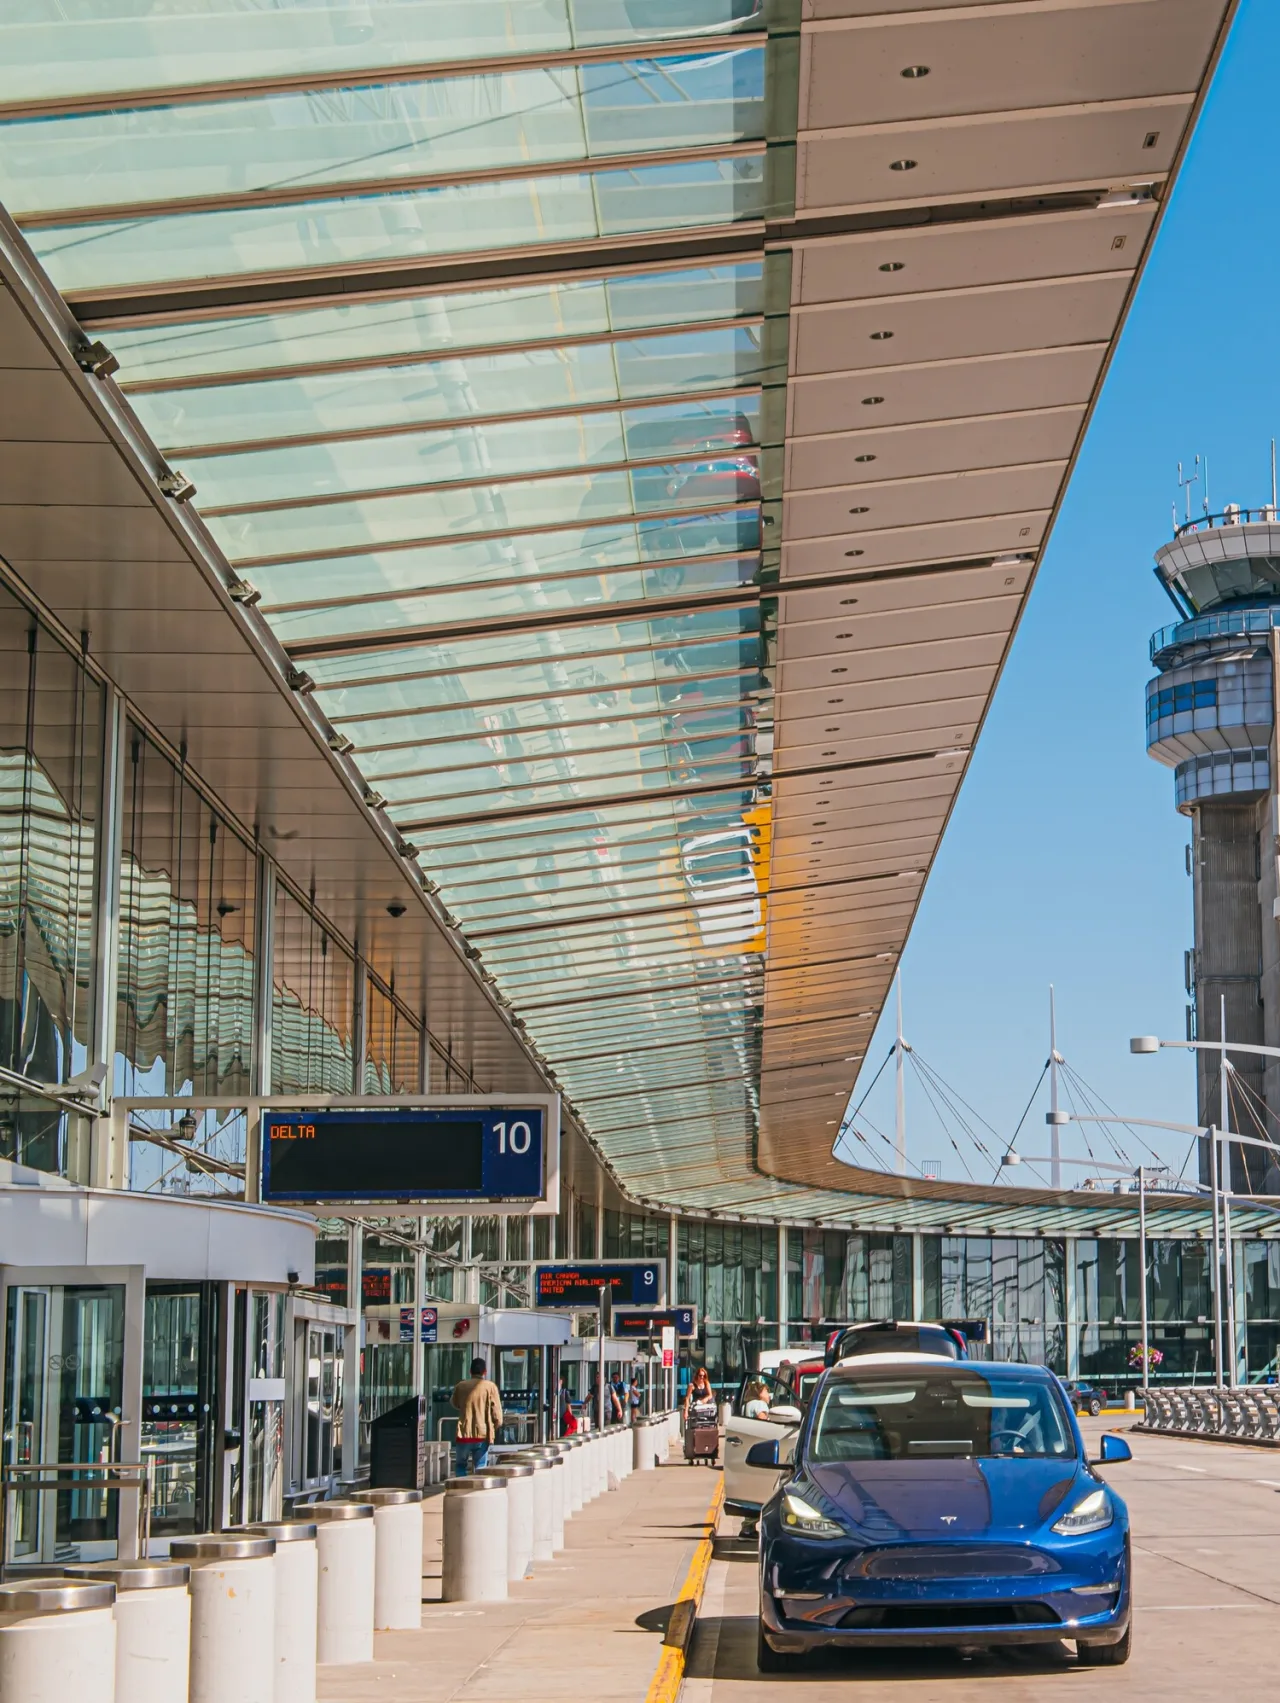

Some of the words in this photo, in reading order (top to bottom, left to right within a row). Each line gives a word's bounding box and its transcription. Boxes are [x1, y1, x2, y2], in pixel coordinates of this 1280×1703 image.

[270, 1124, 315, 1139] DELTA
[492, 1121, 531, 1155] 10
[644, 1270, 654, 1285] 9
[540, 1286, 565, 1294] UNITED
[683, 1312, 691, 1322] 8
